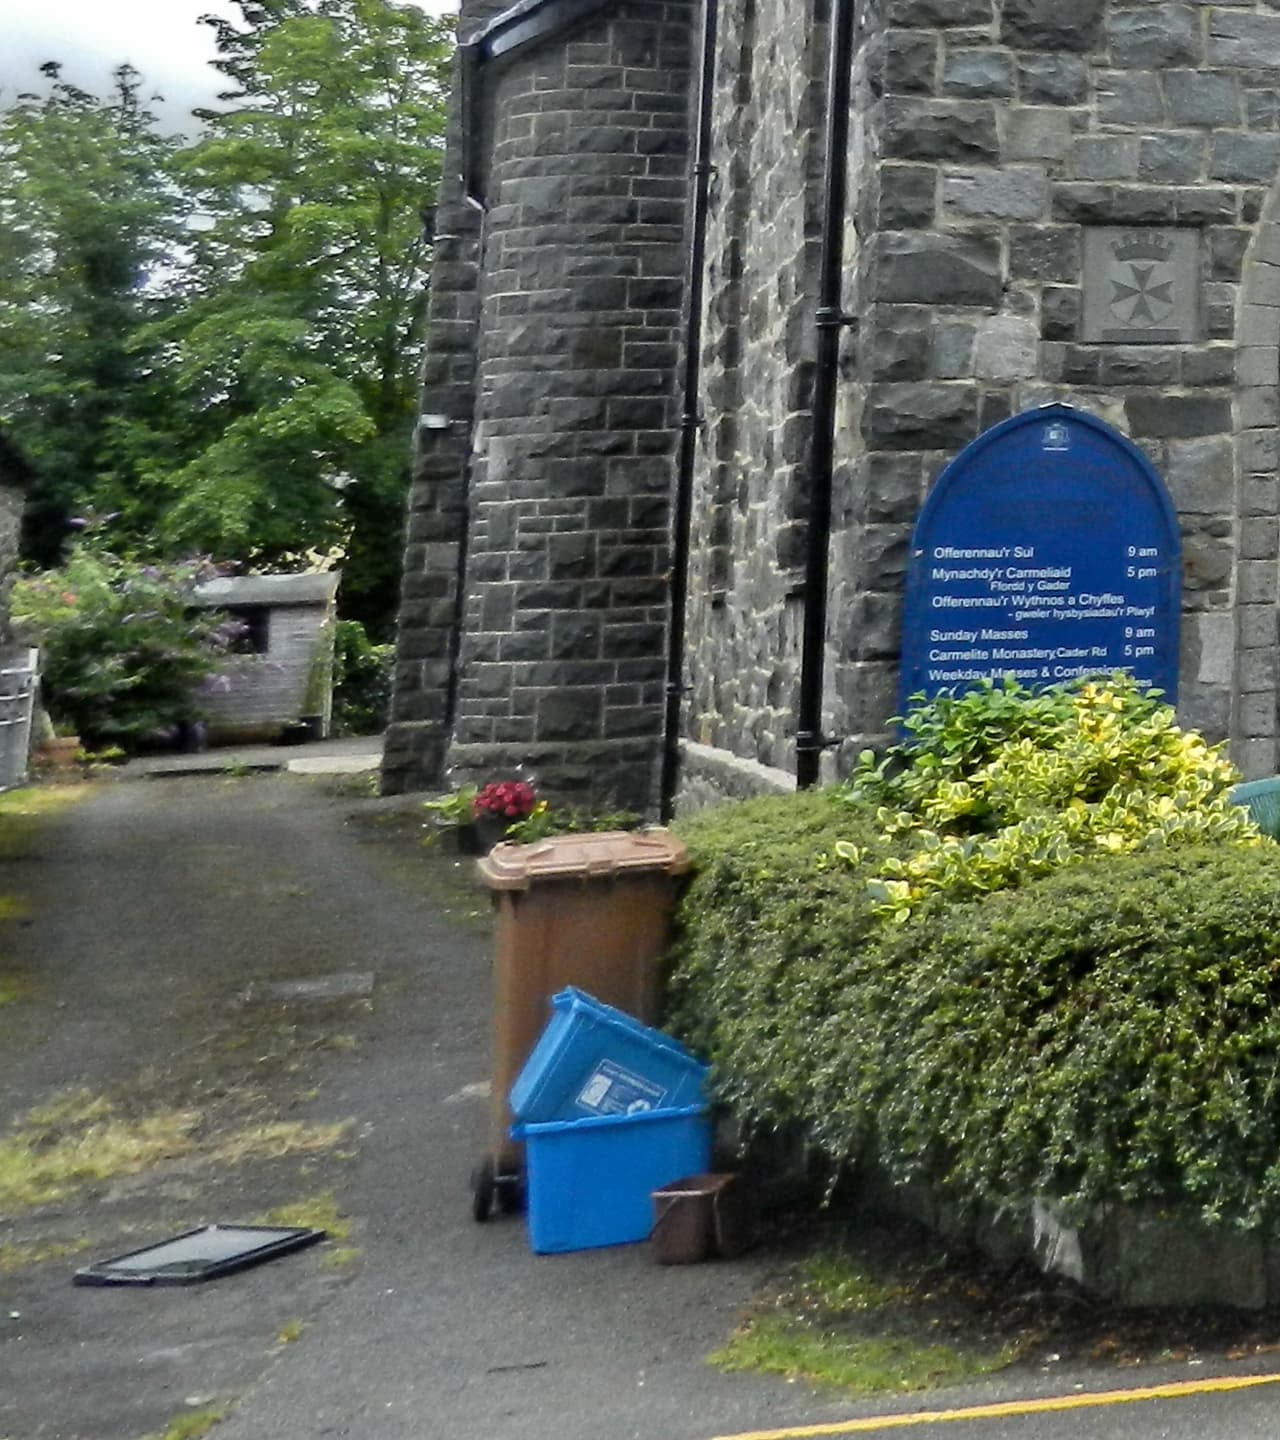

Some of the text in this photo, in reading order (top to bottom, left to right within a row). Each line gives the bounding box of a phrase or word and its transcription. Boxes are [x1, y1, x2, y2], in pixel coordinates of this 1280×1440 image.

[934, 545, 1158, 559] Offerennau'r Sul 9 am
[932, 566, 1157, 582] Mynachdy'r Carmeliaid 5 pm
[990, 580, 1071, 592] Ffordd y Gader
[932, 592, 1125, 609] Offerennau'r Wythnos a Chyffes
[930, 626, 1155, 643] Sunday Masses 9 am
[929, 648, 989, 661] Carmelite
[1092, 646, 1108, 657] Rd
[1124, 644, 1132, 656] 5
[1135, 646, 1155, 658] pm
[928, 668, 988, 681] Weekday
[1041, 666, 1050, 678] &
